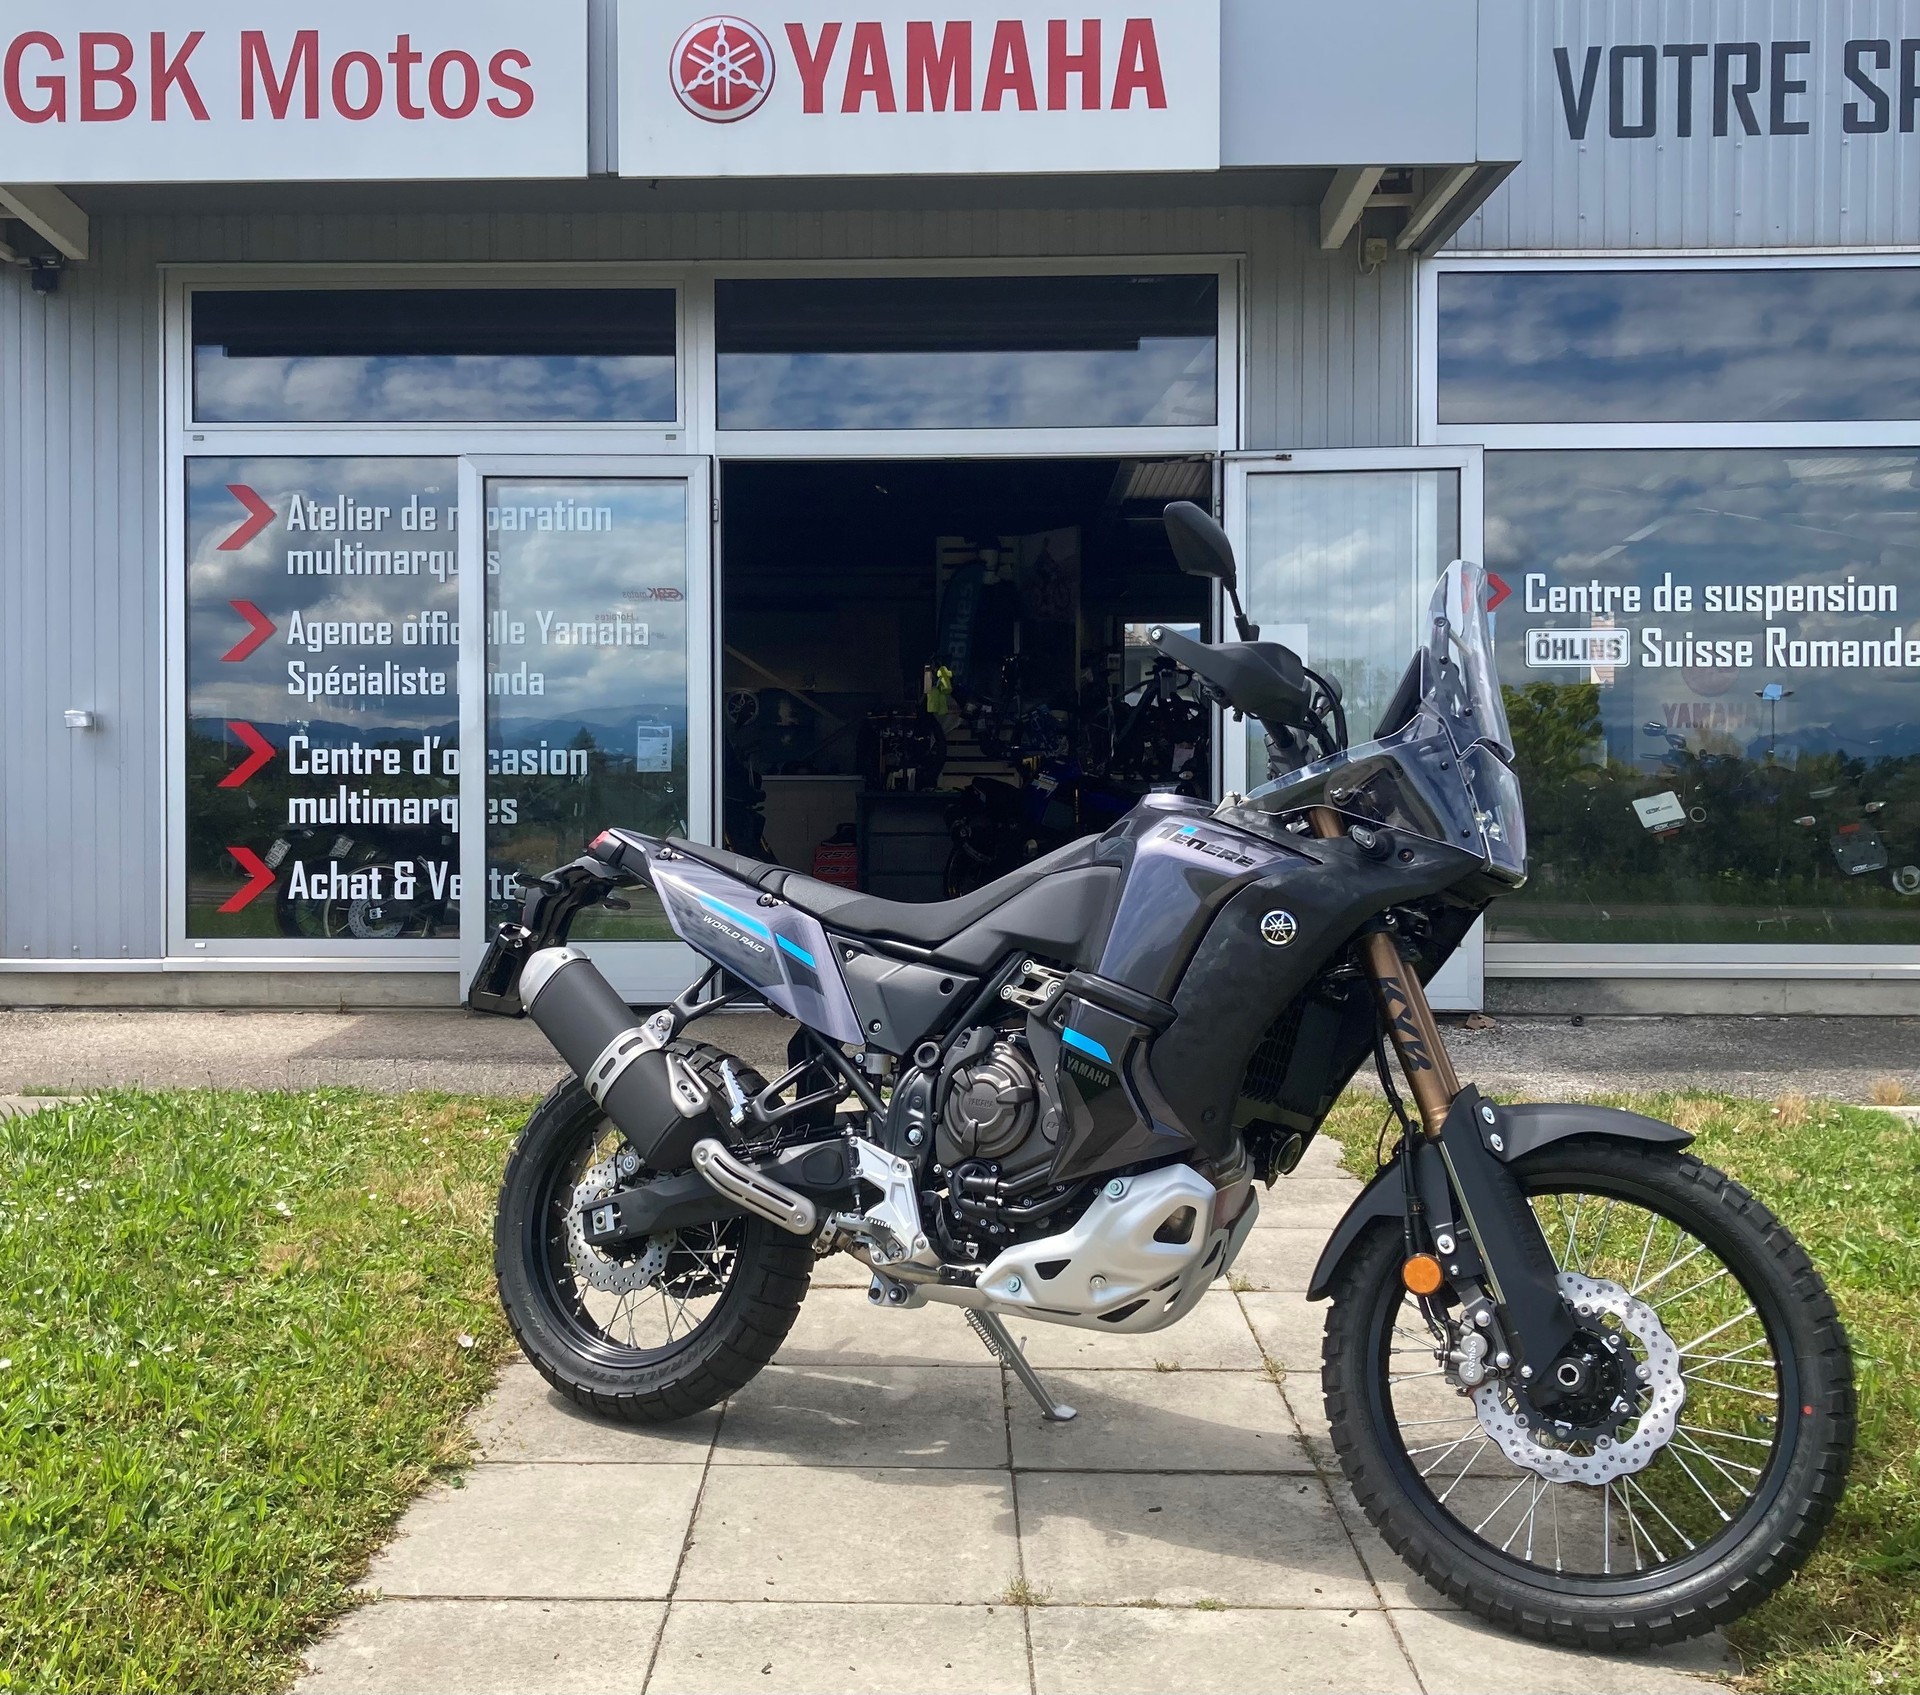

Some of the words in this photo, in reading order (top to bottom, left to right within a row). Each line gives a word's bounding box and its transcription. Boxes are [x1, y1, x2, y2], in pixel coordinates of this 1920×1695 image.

[3, 31, 210, 124] GBK
[241, 29, 534, 121] Motos
[784, 18, 1168, 114] YAMAHA
[1553, 41, 1810, 140] VOTRE
[286, 494, 391, 532] Atelier
[401, 494, 437, 532] de
[448, 498, 613, 540] rparation
[287, 538, 501, 582] multimarqus
[1525, 573, 1641, 613] Centre
[1653, 572, 1693, 613] de
[1705, 575, 1898, 620] suspension
[287, 611, 392, 652] Agence
[402, 610, 525, 646] officlle
[535, 609, 650, 647] Yamaha
[1535, 632, 1622, 661] ÖHLINS
[1641, 628, 1753, 668] Suisse
[1766, 626, 1920, 668] Romande
[287, 660, 447, 702] Spécialiste
[288, 735, 401, 775] Centre
[413, 735, 589, 776] d'ocasion
[288, 784, 518, 833] multimarqes
[815, 865, 857, 874] RST
[816, 850, 857, 860] RST
[288, 861, 382, 901] Achat
[394, 861, 417, 901] &
[428, 861, 519, 901] Vete
[703, 914, 741, 943] WORLD
[738, 932, 766, 954] RAID
[1066, 1055, 1111, 1087] YAMAHA
[1465, 1340, 1477, 1378] brembo
